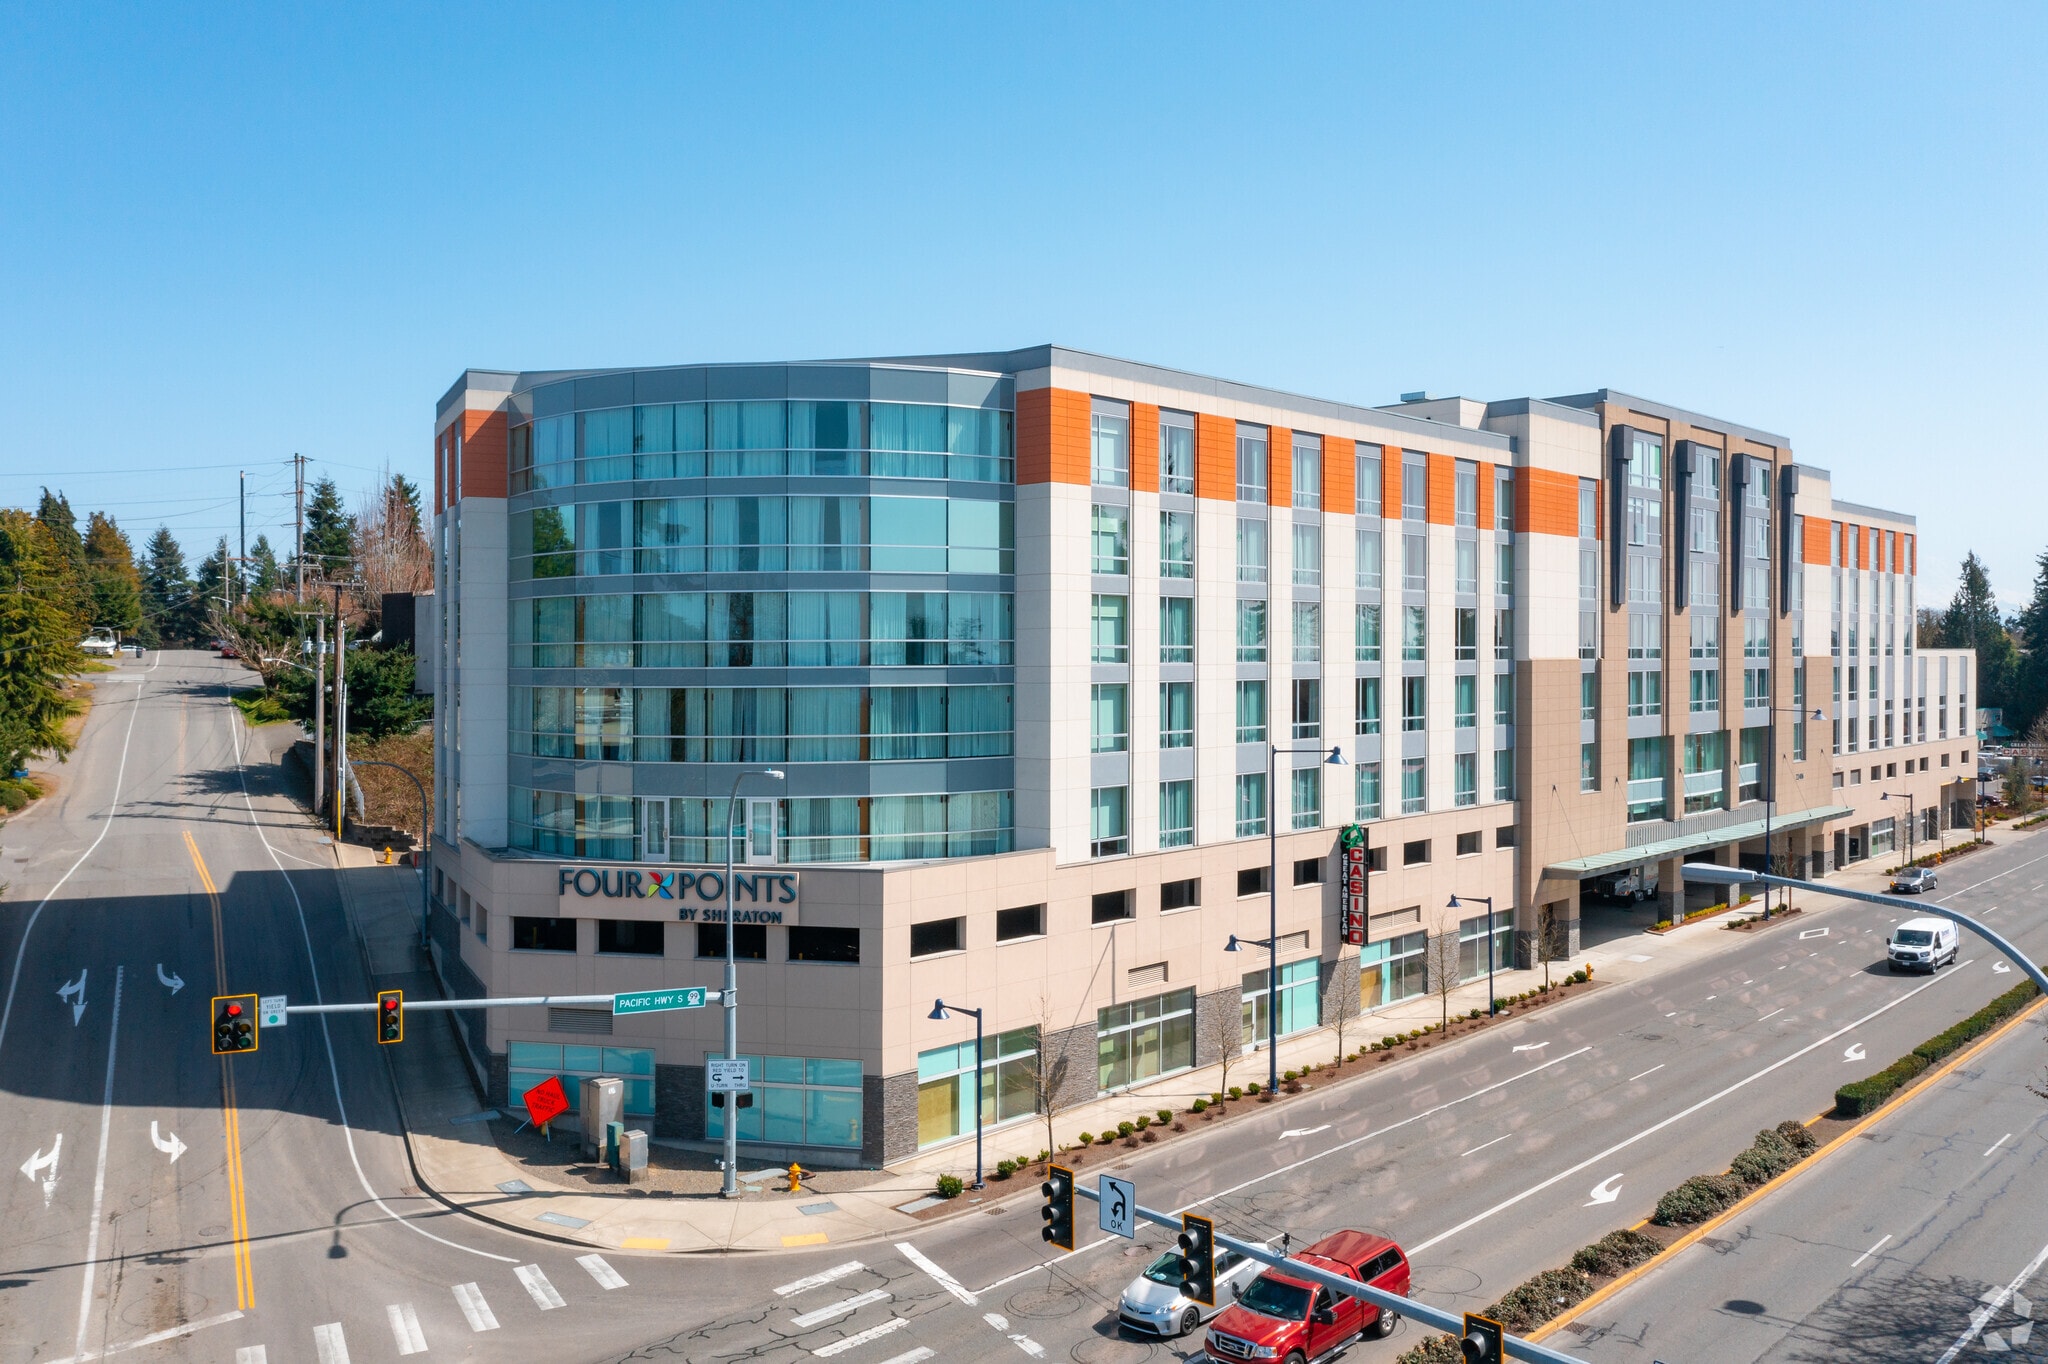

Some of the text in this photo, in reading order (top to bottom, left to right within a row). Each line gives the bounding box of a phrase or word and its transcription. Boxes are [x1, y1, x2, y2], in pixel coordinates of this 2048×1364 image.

[559, 868, 796, 904] FOUR PONTS
[1349, 848, 1363, 944] CASINO
[679, 908, 698, 921] BY
[619, 992, 698, 1008] PACIFIC HWY S 99
[1110, 1219, 1123, 1231] OK
